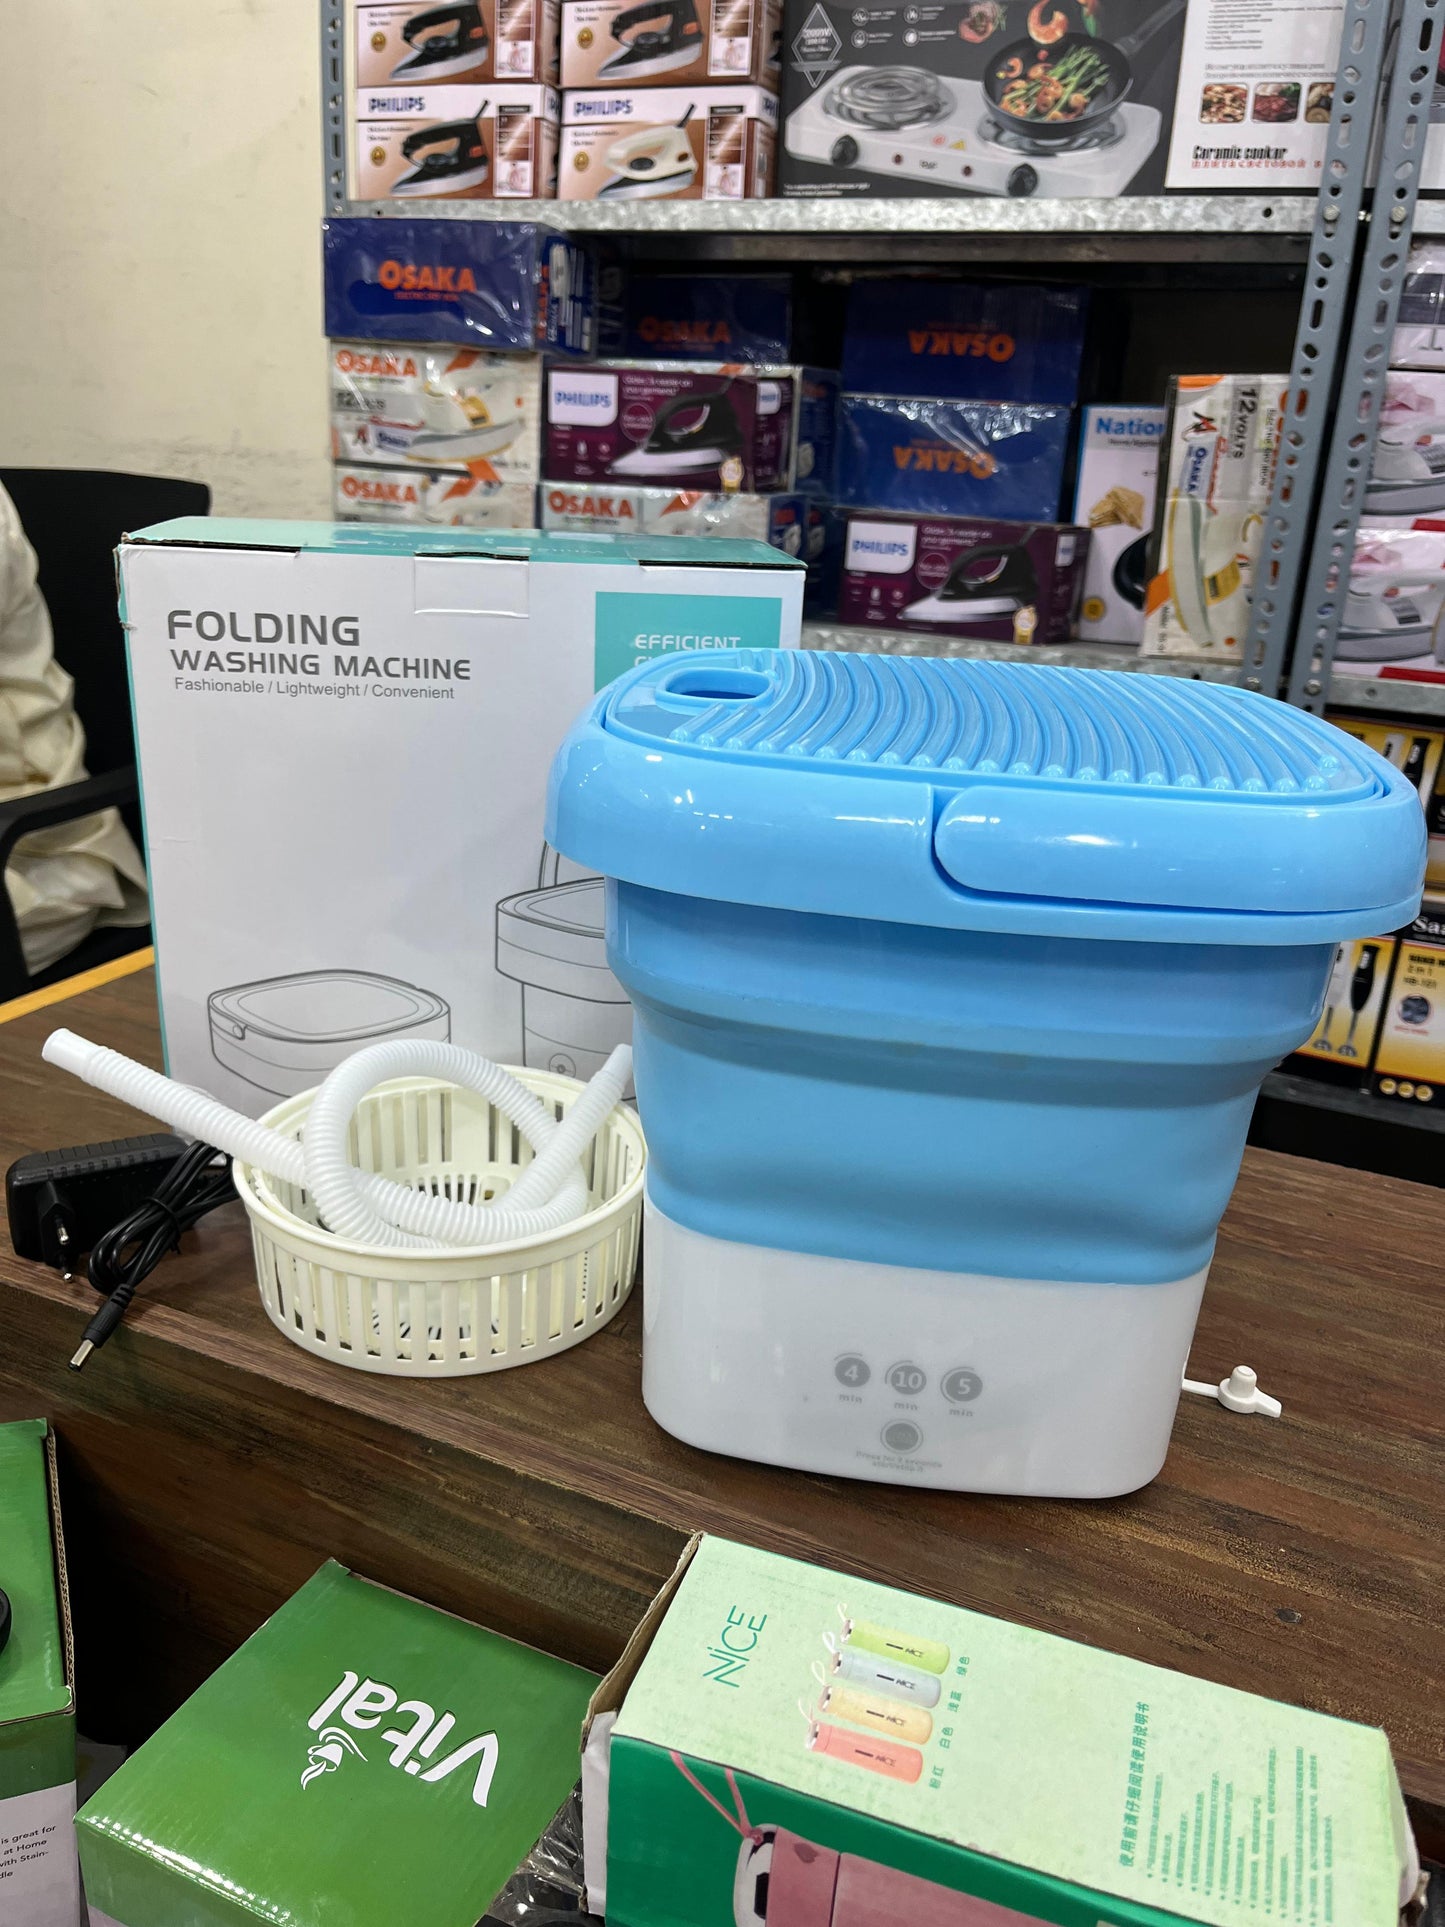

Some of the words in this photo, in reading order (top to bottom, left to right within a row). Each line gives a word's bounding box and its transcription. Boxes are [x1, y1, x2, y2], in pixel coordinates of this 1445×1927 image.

[369, 97, 424, 112] PHILIPS
[574, 99, 633, 117] PHILIPS
[379, 260, 477, 293] OSAKA
[639, 315, 731, 343] OSAKA
[909, 332, 1014, 362] OSAKA
[336, 349, 417, 377] OSAKA
[554, 391, 612, 408] PHILIPS
[894, 447, 997, 479] OSAKA
[341, 476, 418, 503] OSAKA
[549, 490, 634, 519] OSAKA
[852, 539, 908, 555] PHILIPS
[168, 609, 360, 647] FOLDING
[634, 634, 741, 651] EFFICIENT
[171, 649, 321, 676] WASHING
[334, 655, 471, 681] MACHINE
[175, 678, 264, 694] Fashionable
[277, 681, 360, 699] Lightweight
[371, 685, 454, 699] Convenient
[844, 1364, 859, 1382] 4
[894, 1371, 923, 1390] 10
[957, 1378, 972, 1395] 5
[839, 1393, 863, 1404] min
[894, 1401, 919, 1411] min
[949, 1408, 973, 1417] min
[306, 1671, 500, 1807] Vital
[939, 1725, 955, 1750] 白色
[1120, 1702, 1150, 1866] 使用前请仔细阅读使用说明书
[12, 1830, 38, 1843] great
[42, 1825, 56, 1834] for
[17, 1840, 47, 1851] Home
[20, 1851, 49, 1862] Stain-
